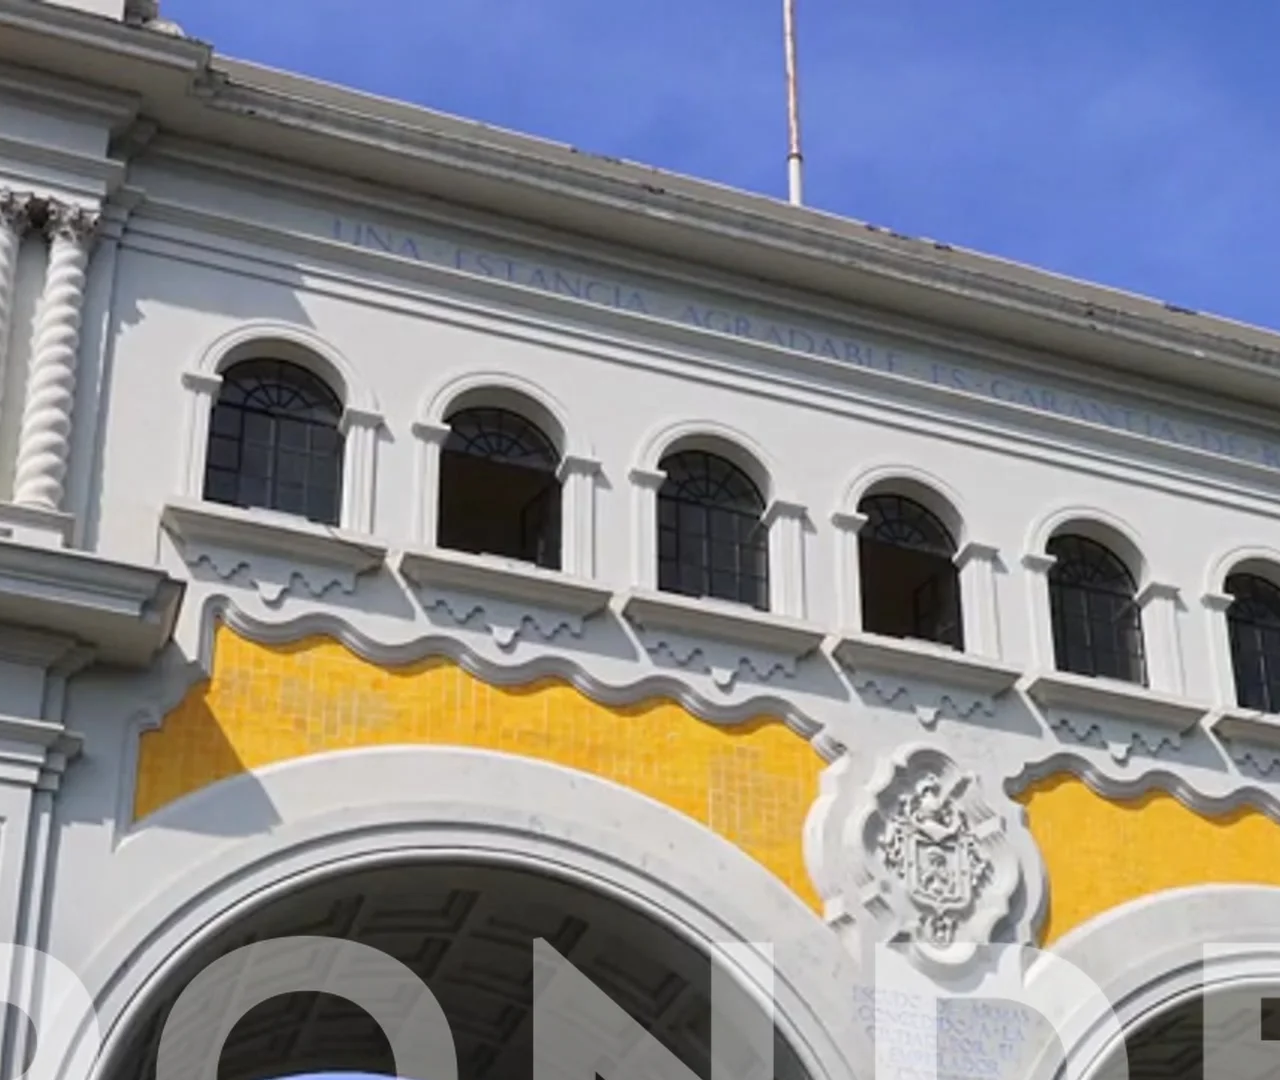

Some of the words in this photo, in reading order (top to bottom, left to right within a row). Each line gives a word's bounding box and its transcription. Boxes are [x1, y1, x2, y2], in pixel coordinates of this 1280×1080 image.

[332, 218, 420, 260] UNA
[454, 247, 650, 315] ESTANCIA
[679, 305, 903, 373] AGRADABLE
[930, 362, 972, 388] ES
[990, 378, 1178, 441] GARANTIA
[1197, 429, 1249, 456] DE
